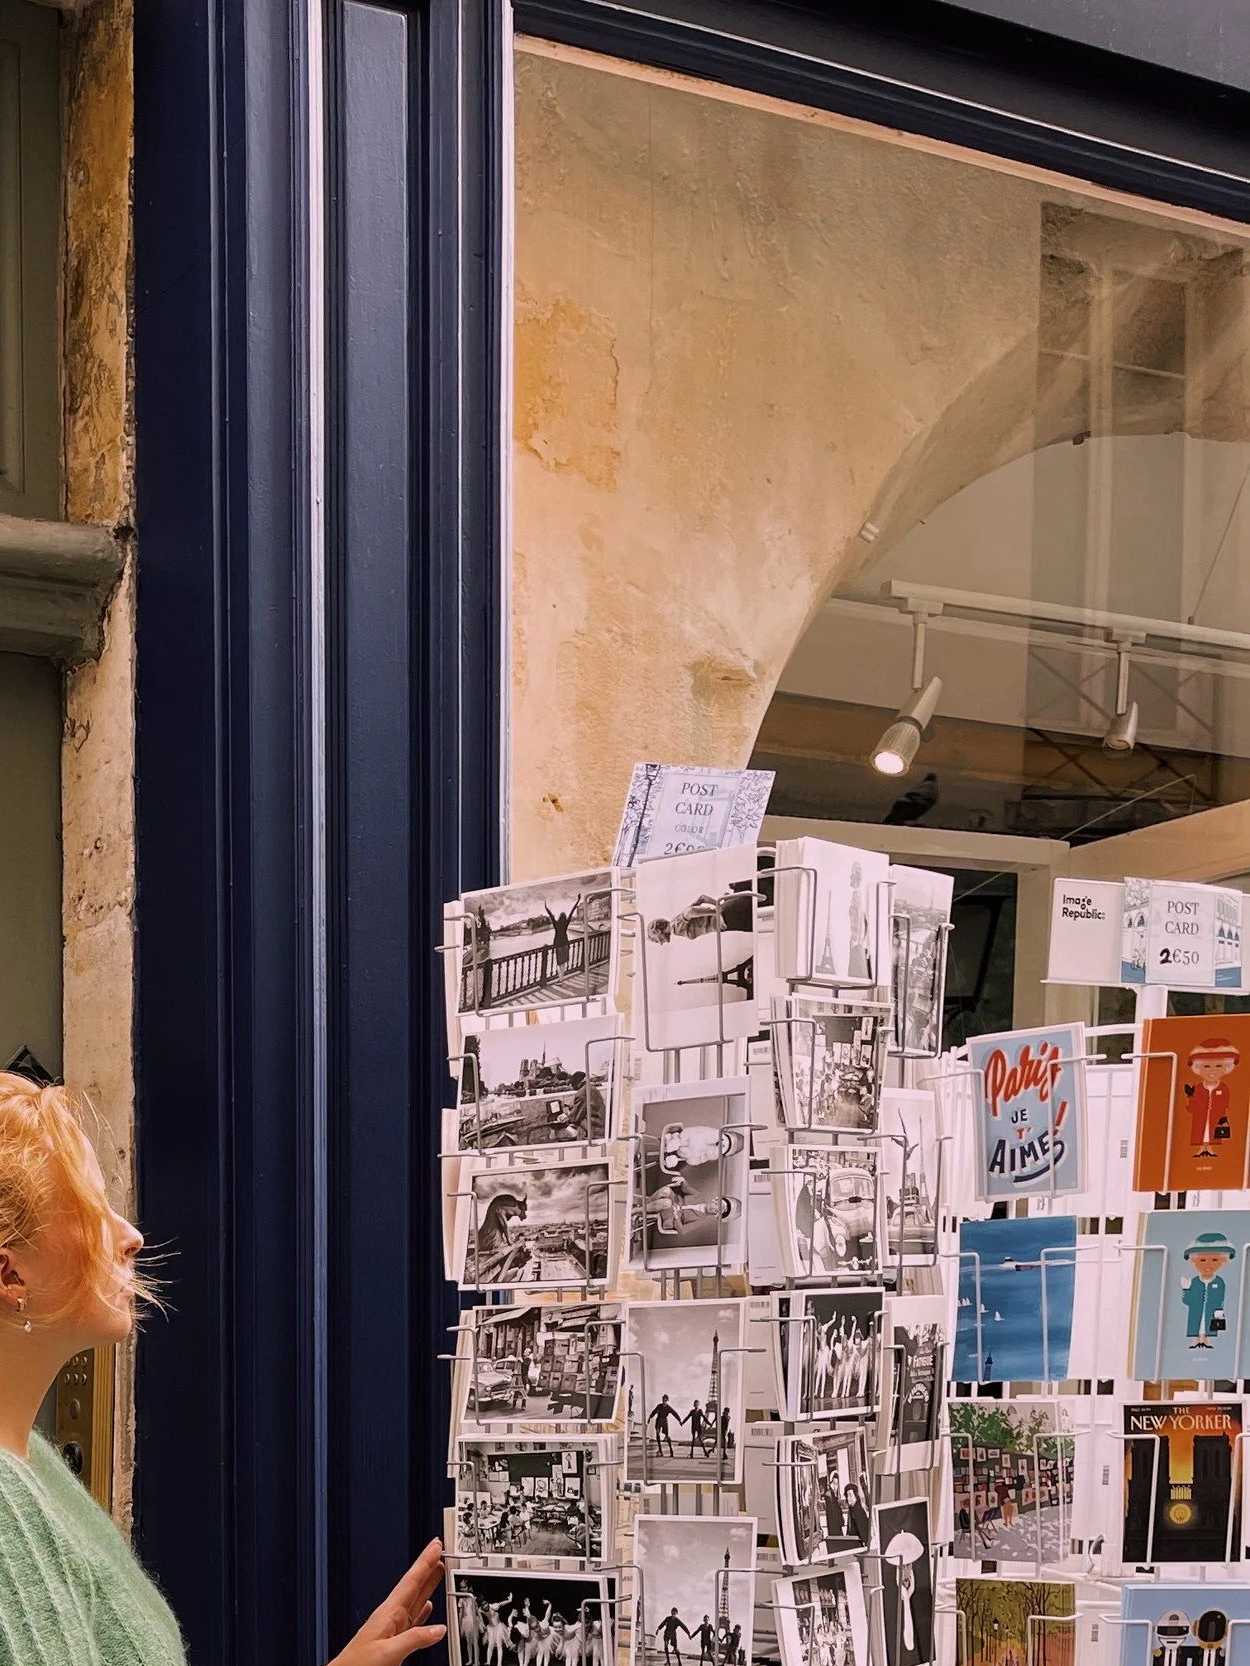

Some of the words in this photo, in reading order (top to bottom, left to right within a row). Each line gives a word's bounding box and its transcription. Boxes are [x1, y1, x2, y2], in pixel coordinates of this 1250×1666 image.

[681, 782, 718, 796] POST
[675, 802, 714, 816] CARD
[674, 824, 704, 834] COLOR
[1062, 893, 1092, 910] Image
[1167, 900, 1200, 915] POST
[1164, 920, 1200, 935] CARD
[1159, 947, 1200, 965] 2€50
[983, 1041, 1062, 1117] Paris
[1011, 1108, 1028, 1124] JE
[1173, 1407, 1190, 1415] THE
[1130, 1415, 1168, 1431] NEW
[1169, 1414, 1233, 1431] YORKER
